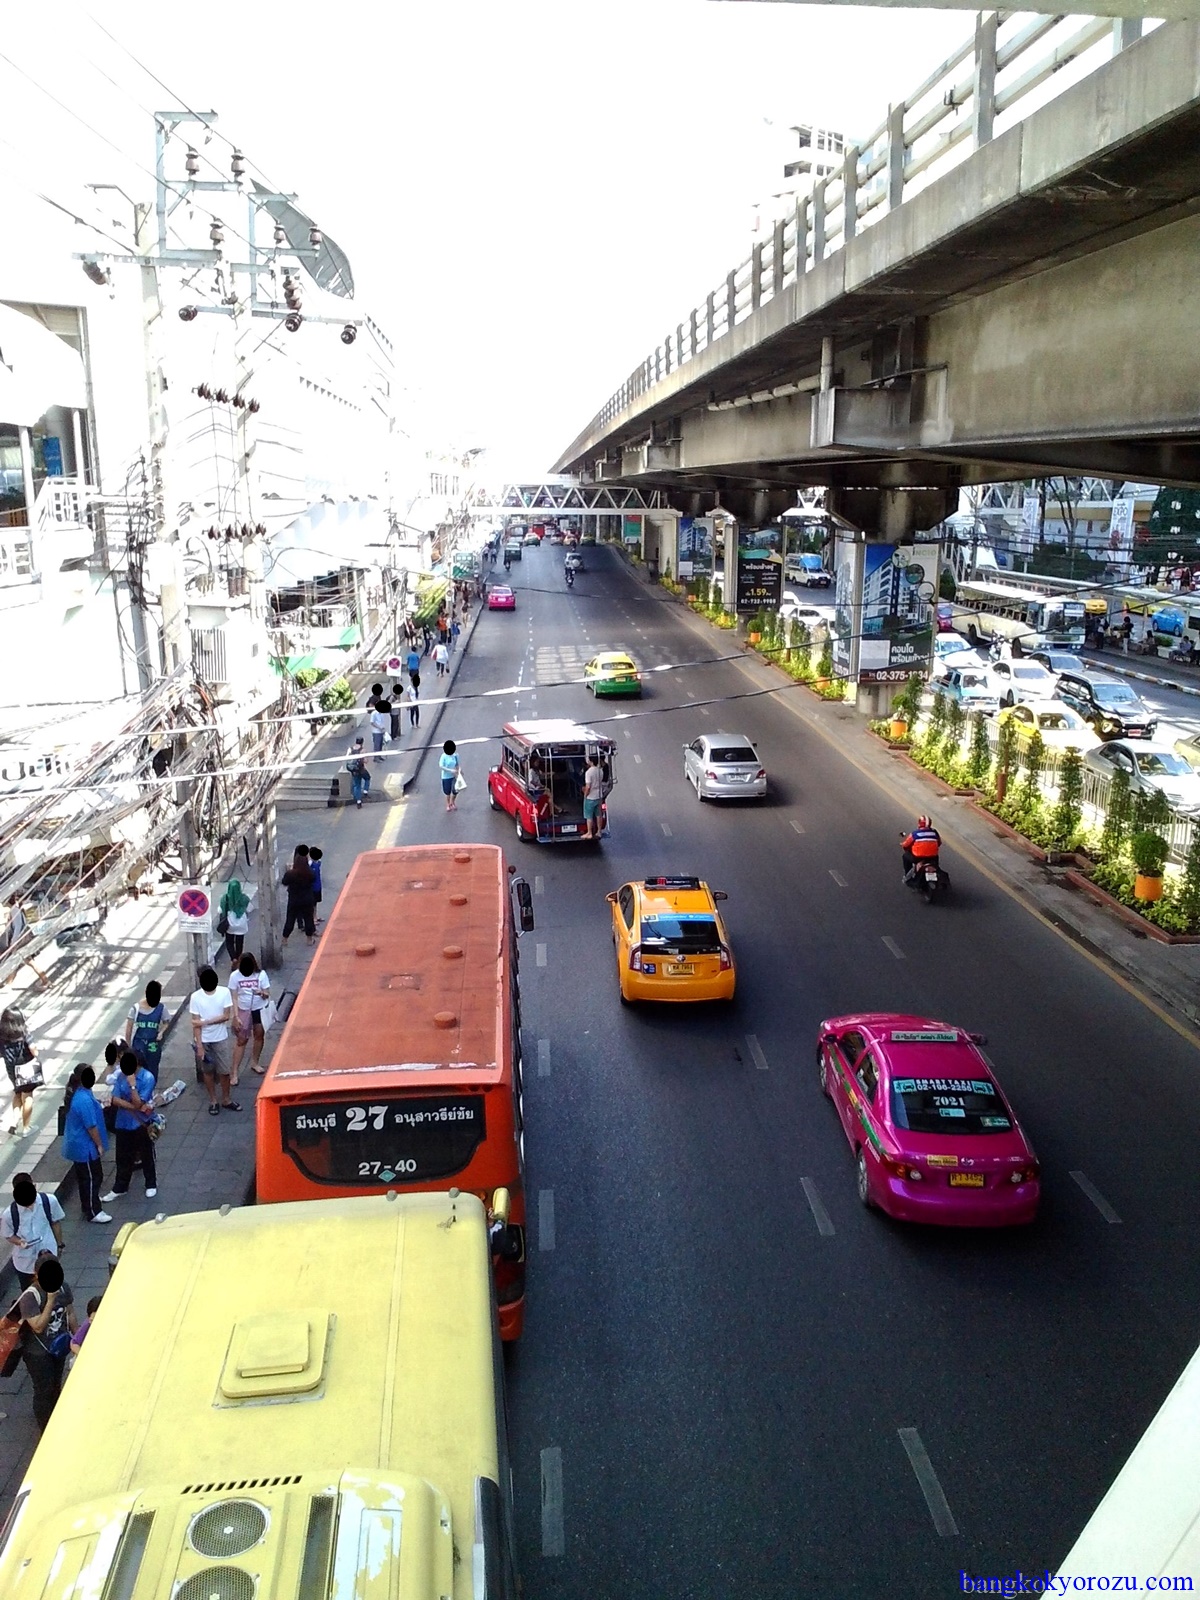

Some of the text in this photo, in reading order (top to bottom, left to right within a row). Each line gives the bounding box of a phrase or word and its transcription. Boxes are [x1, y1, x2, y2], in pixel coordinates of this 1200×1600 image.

[891, 643, 914, 654] คอนโด
[933, 1096, 966, 1106] 7021
[295, 1113, 337, 1133] มีนบุรี
[345, 1105, 389, 1132] 27
[394, 1107, 475, 1127] อนุสาวรีย์ชัย
[358, 1159, 417, 1176] 27-40
